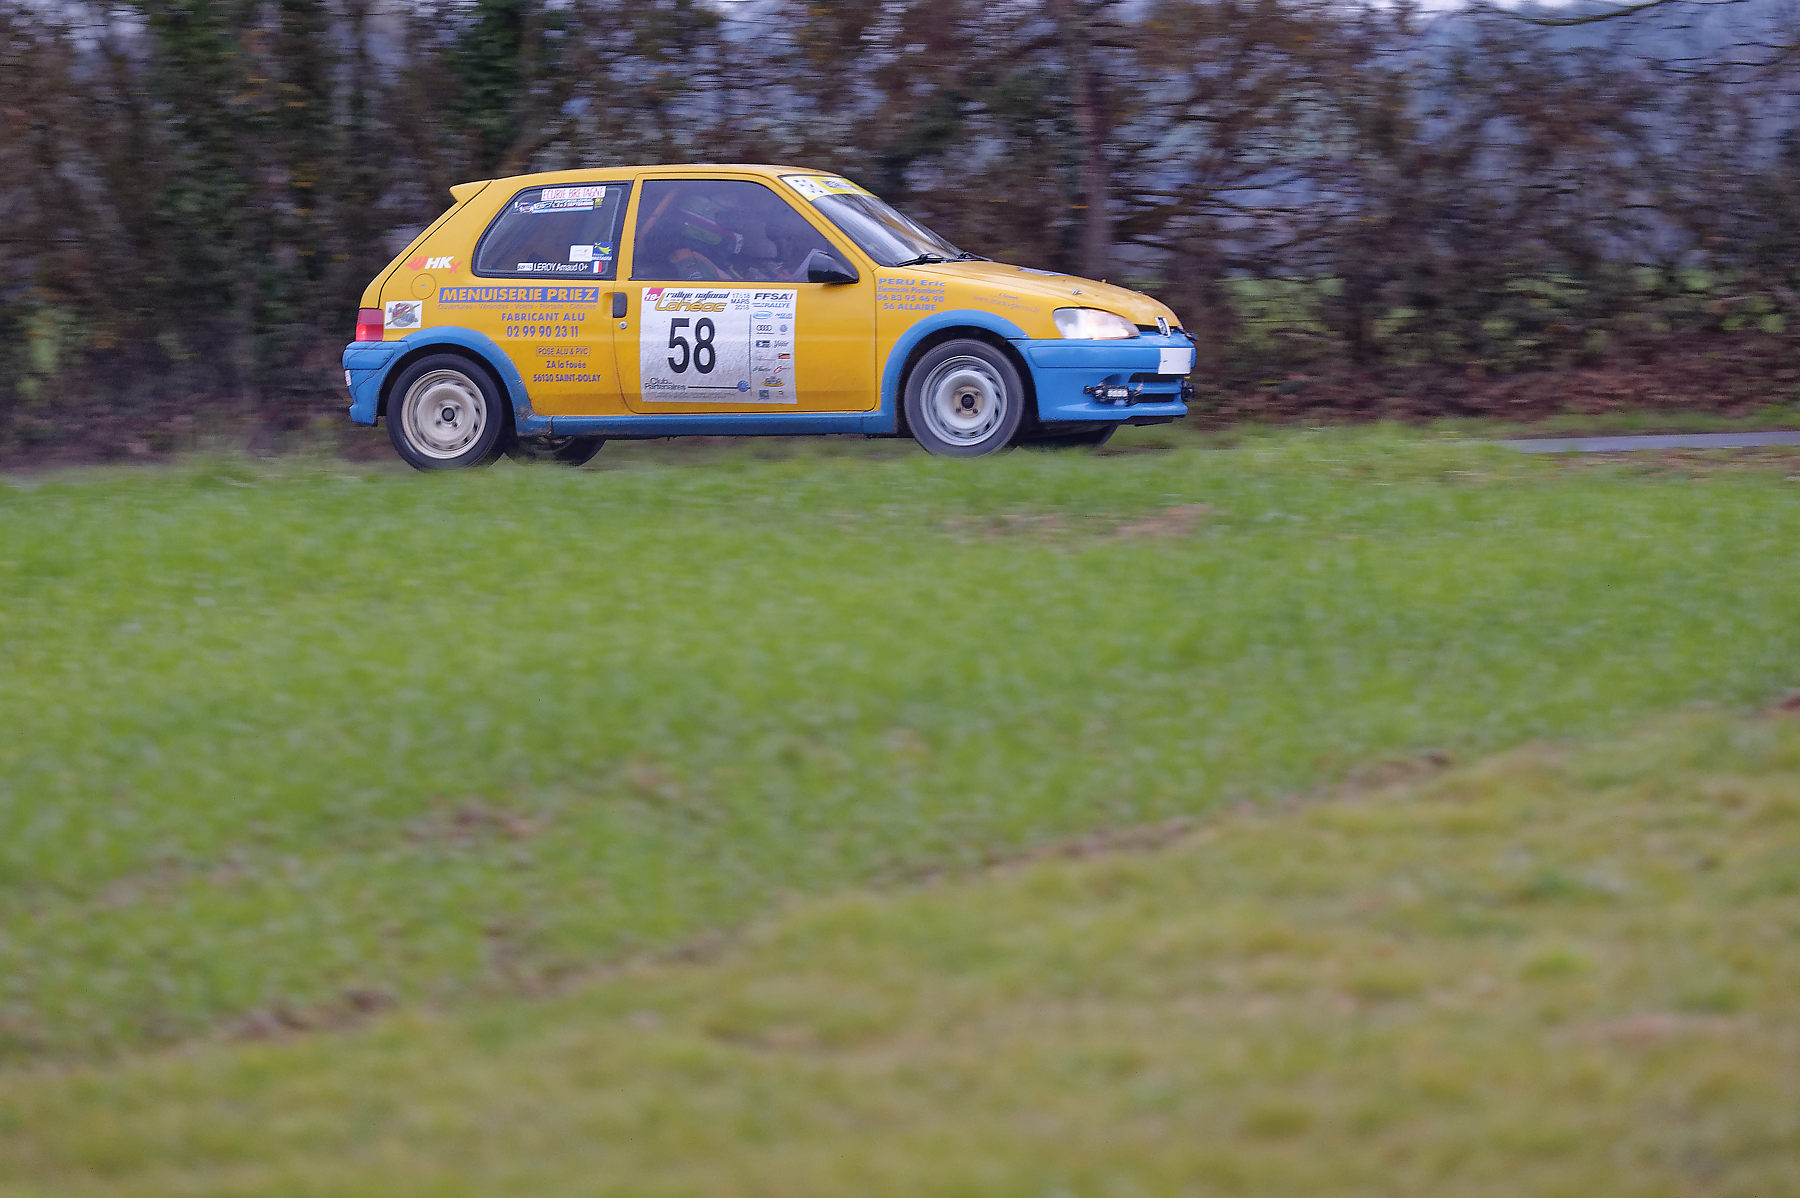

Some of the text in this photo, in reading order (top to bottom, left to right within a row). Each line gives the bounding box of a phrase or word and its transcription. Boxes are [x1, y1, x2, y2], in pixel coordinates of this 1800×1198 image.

[533, 262, 556, 272] LEROY
[878, 278, 945, 287] PERU Eric
[441, 288, 596, 301] MENUISERIE PRIEZ
[753, 292, 790, 300] FFSA
[905, 294, 916, 302] 95
[655, 292, 728, 312] Lohéac
[897, 303, 937, 311] ALLAIRE
[501, 312, 585, 321] FABRICANT ALU
[506, 325, 579, 337] 02 99 90 23 11
[667, 317, 716, 374] 58
[538, 347, 555, 355] POSE
[575, 347, 588, 355] PVC
[546, 360, 556, 368] ZA
[533, 374, 601, 382] 56130 SAINT-DOLAY
